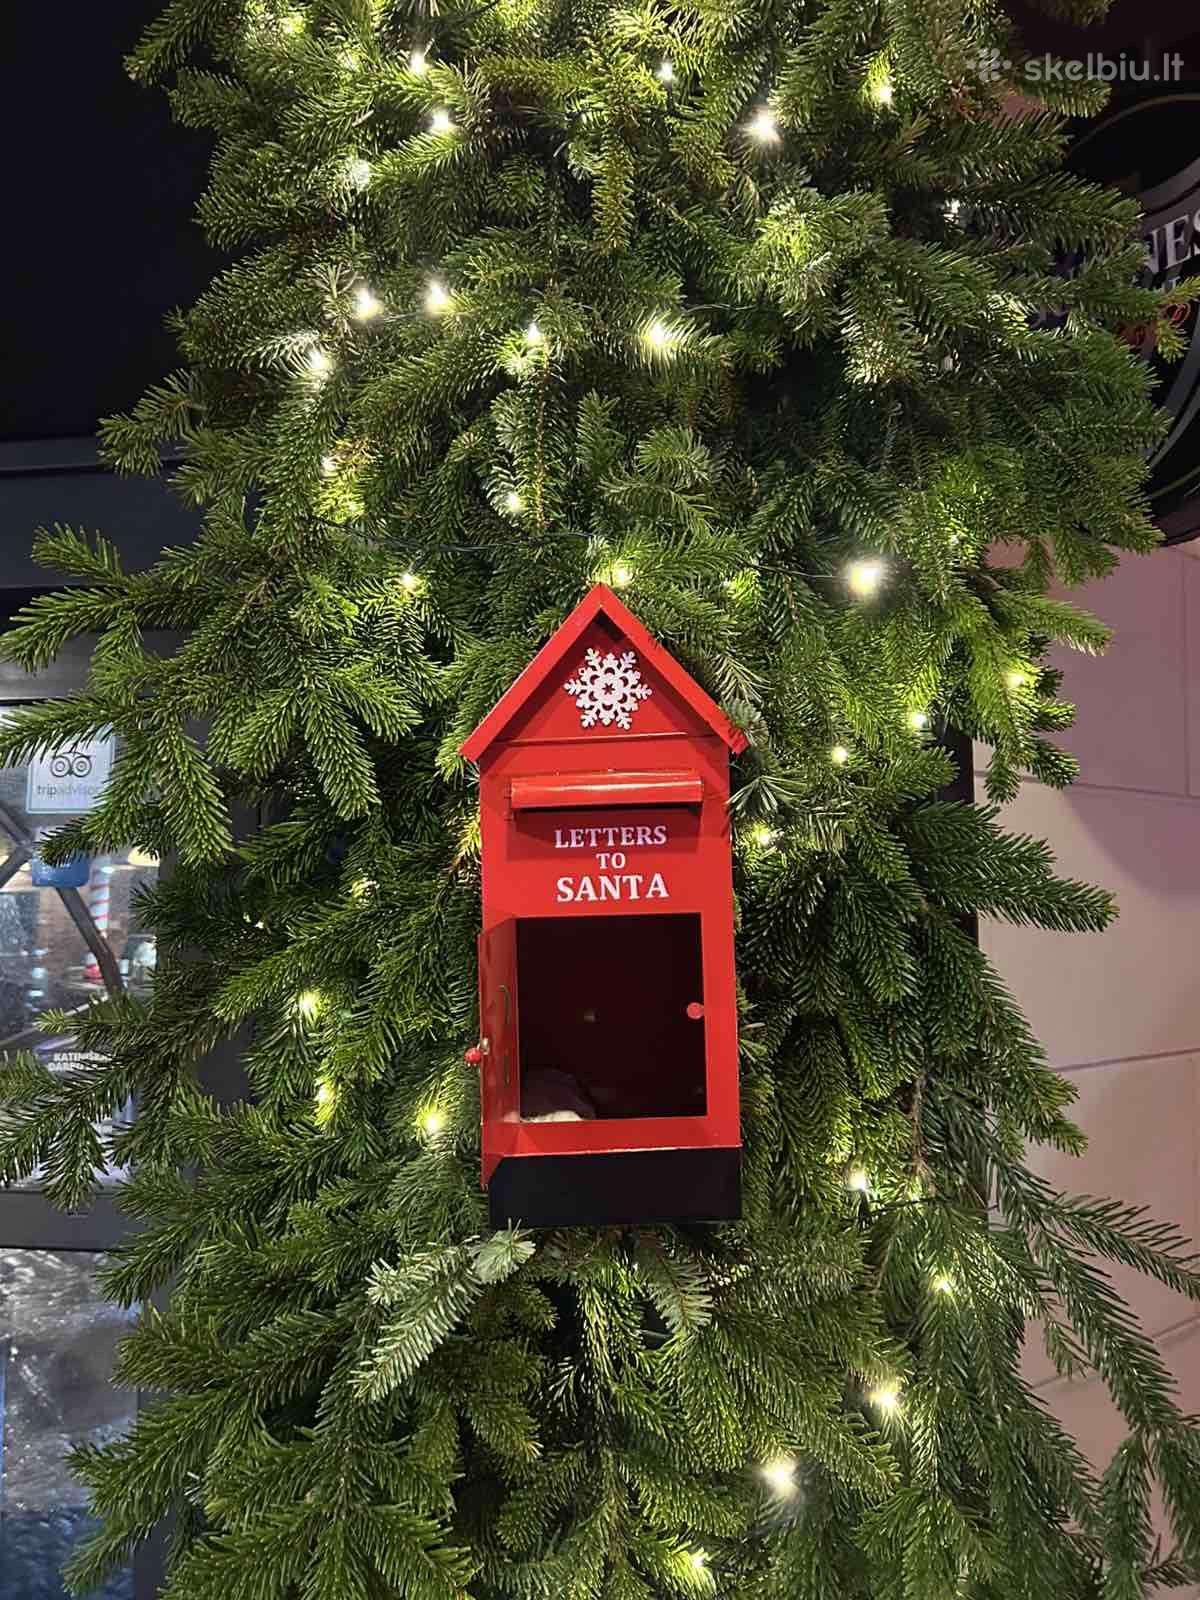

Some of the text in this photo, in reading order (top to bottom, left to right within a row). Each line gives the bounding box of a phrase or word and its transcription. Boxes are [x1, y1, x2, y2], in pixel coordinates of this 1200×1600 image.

[554, 825, 668, 849] LETTERS
[596, 852, 626, 870] TO
[556, 872, 670, 903] SANTA
